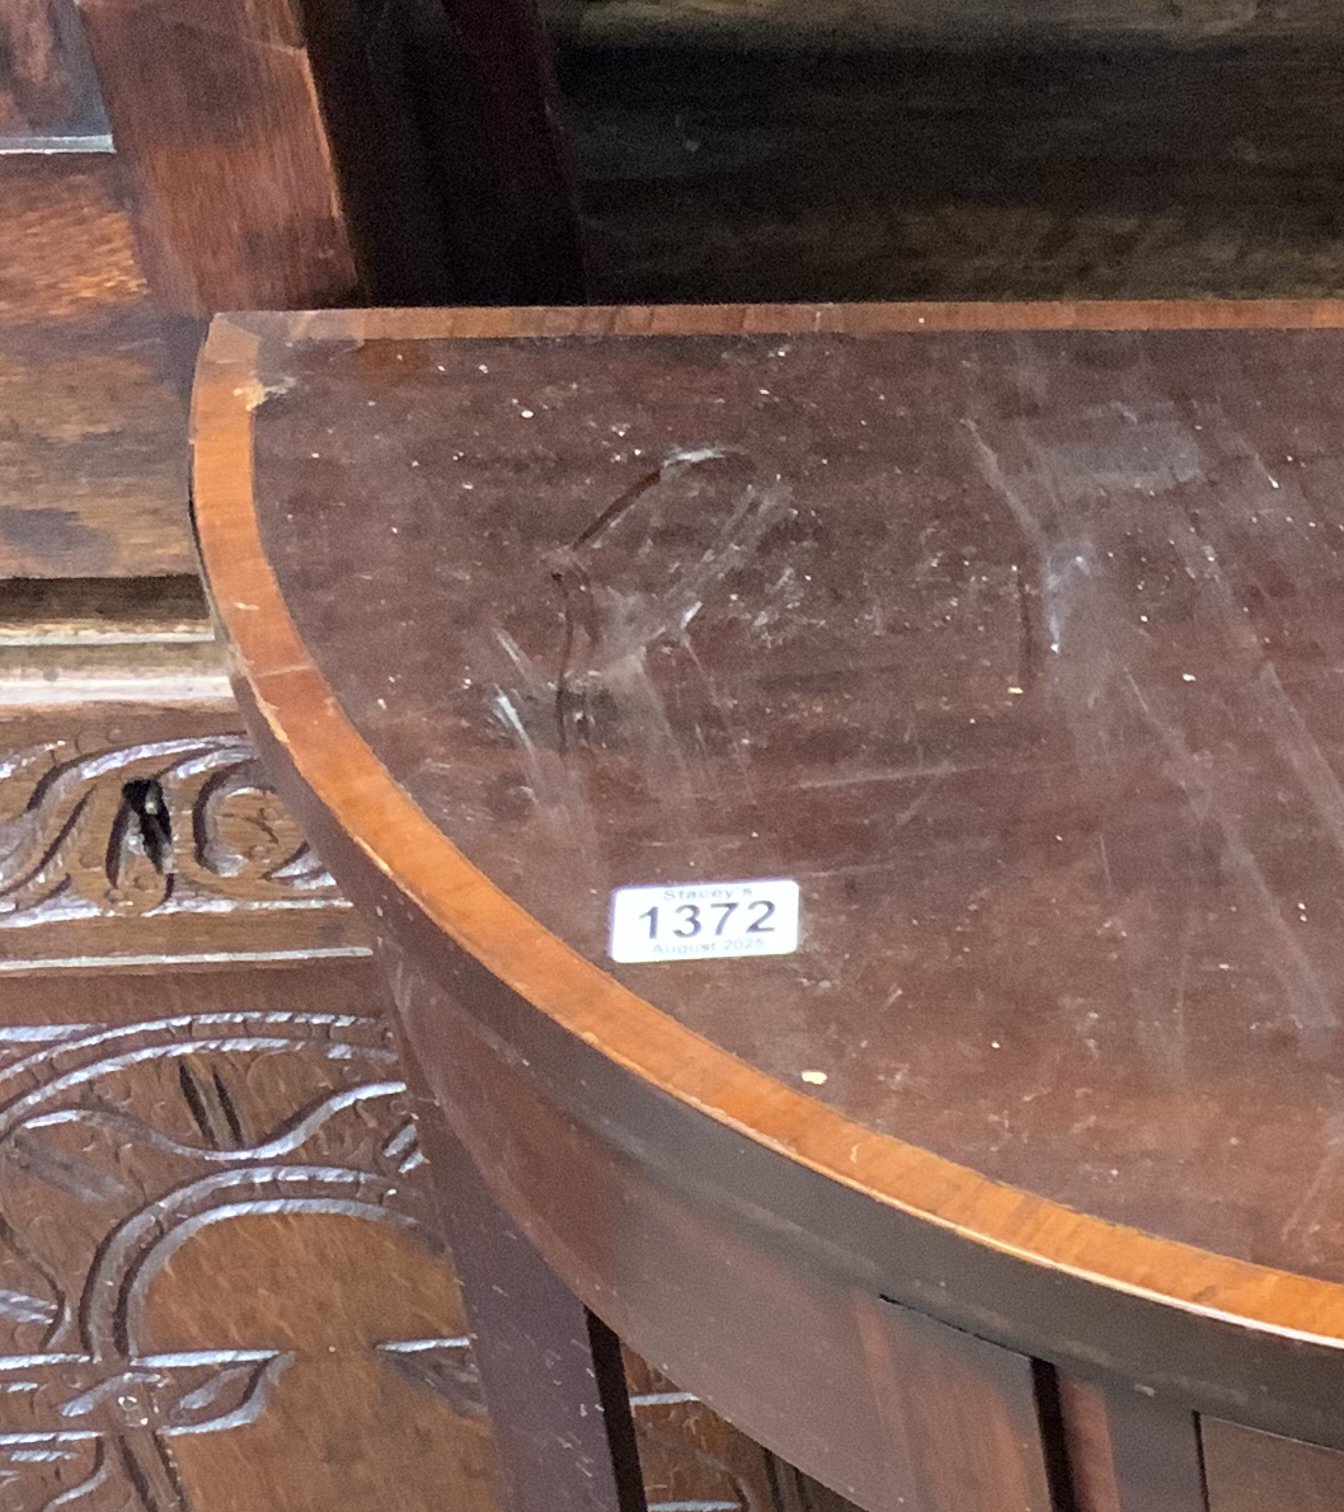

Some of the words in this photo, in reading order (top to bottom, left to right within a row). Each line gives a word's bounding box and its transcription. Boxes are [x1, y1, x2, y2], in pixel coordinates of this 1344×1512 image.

[663, 886, 752, 900] Stacey's
[639, 900, 777, 939] 1372
[652, 941, 717, 955] August
